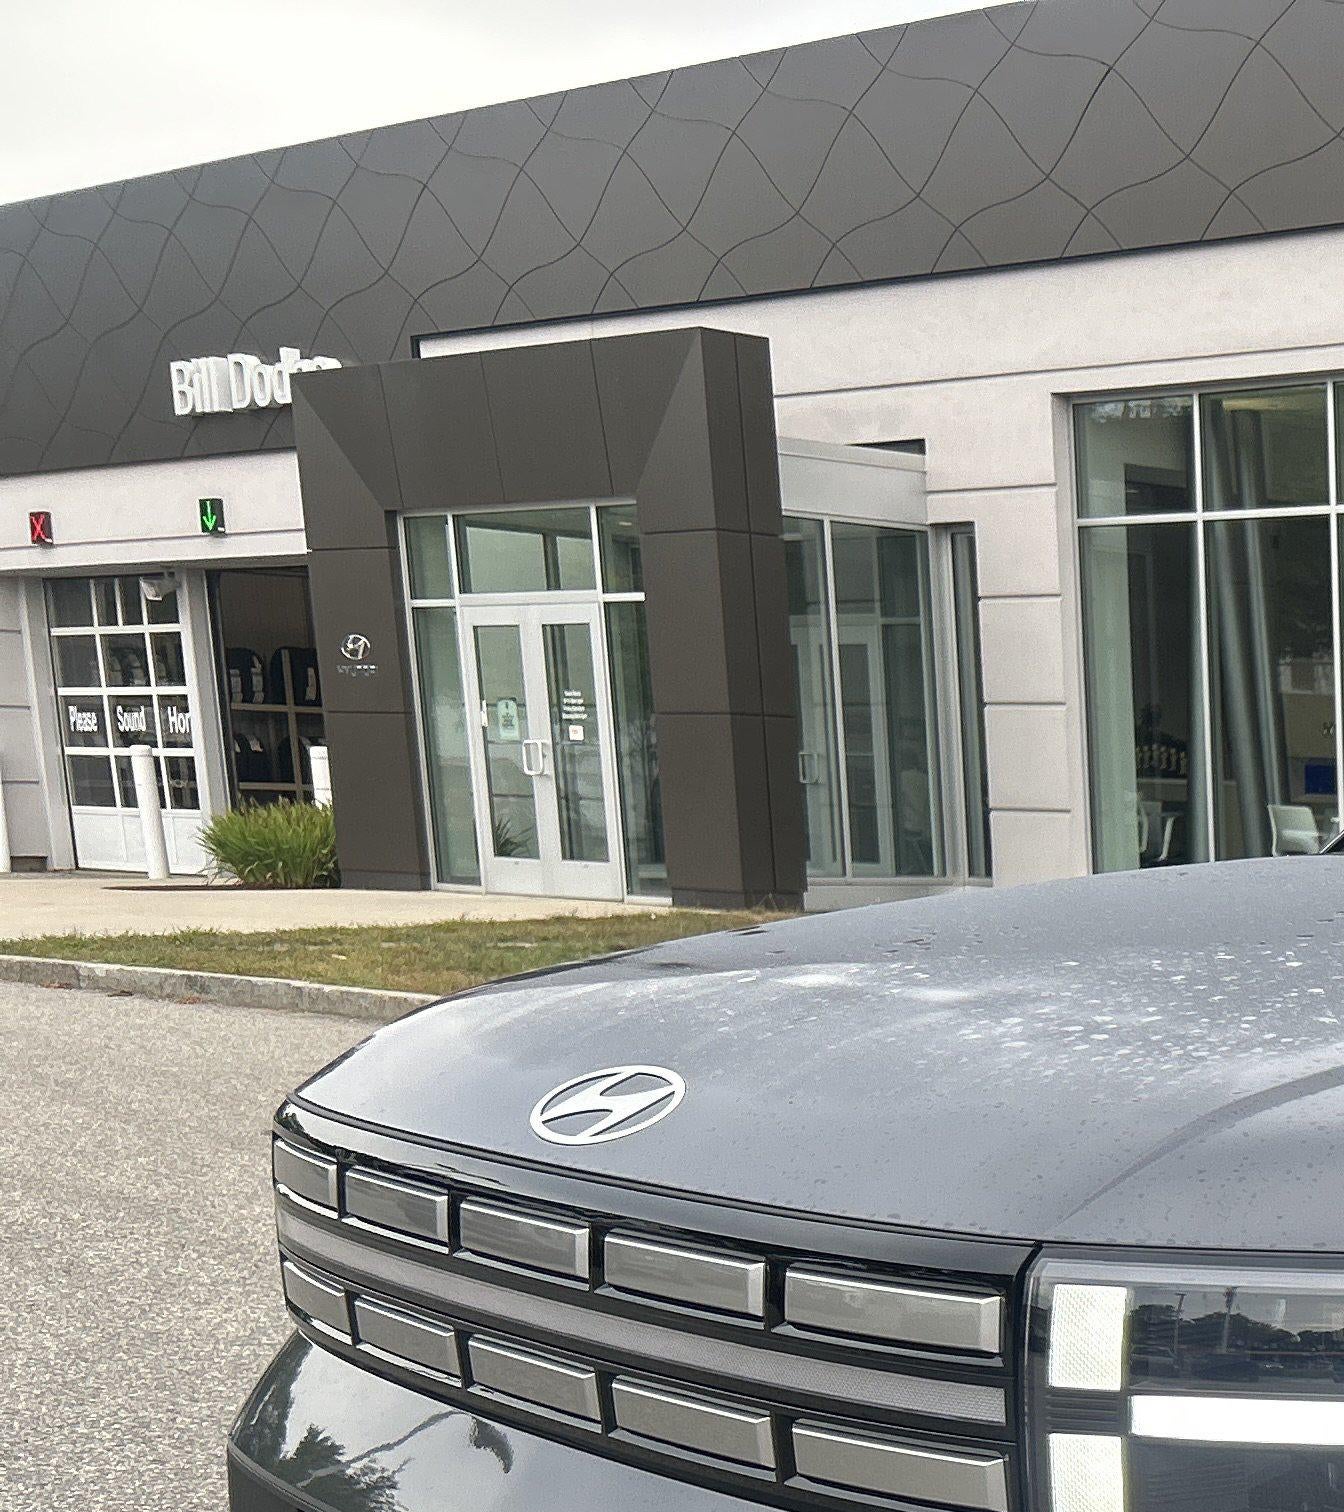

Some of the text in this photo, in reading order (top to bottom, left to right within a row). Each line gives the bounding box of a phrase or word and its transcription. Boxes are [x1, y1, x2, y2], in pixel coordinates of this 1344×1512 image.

[170, 347, 342, 416] Bill Dod
[68, 705, 191, 733] Please Sound Hor
